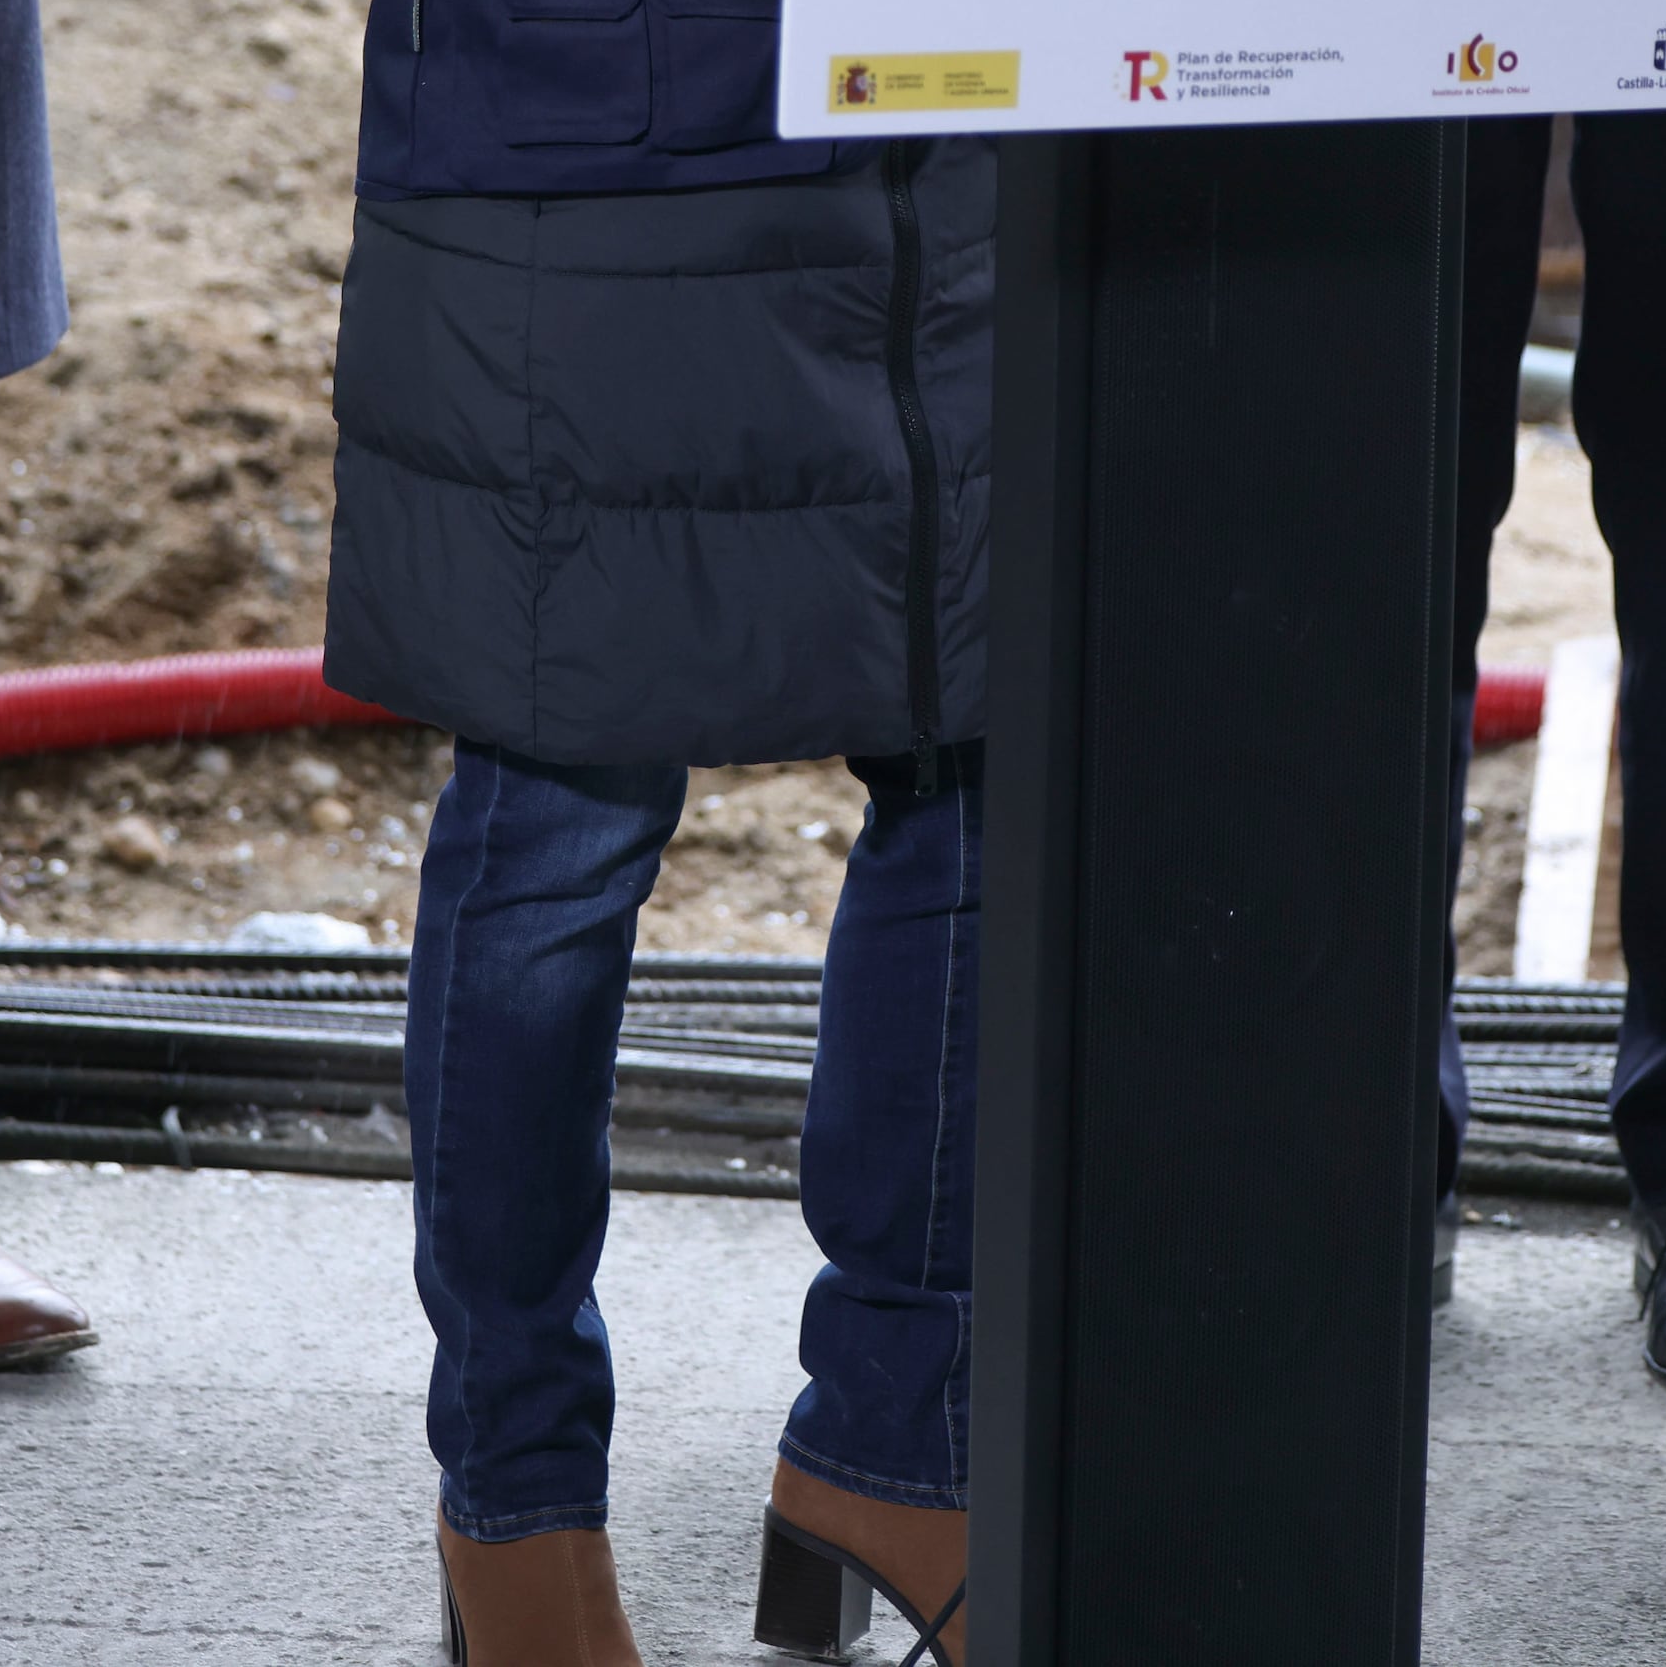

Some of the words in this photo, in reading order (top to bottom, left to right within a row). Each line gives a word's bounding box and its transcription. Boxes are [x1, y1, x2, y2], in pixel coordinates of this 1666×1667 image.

[1177, 51, 1210, 65] Plan
[1214, 51, 1233, 64] de
[1238, 48, 1344, 64] Recuperación,
[1177, 67, 1294, 82] Transformación
[1177, 89, 1185, 101] y
[1190, 83, 1271, 98] Resiliencia
